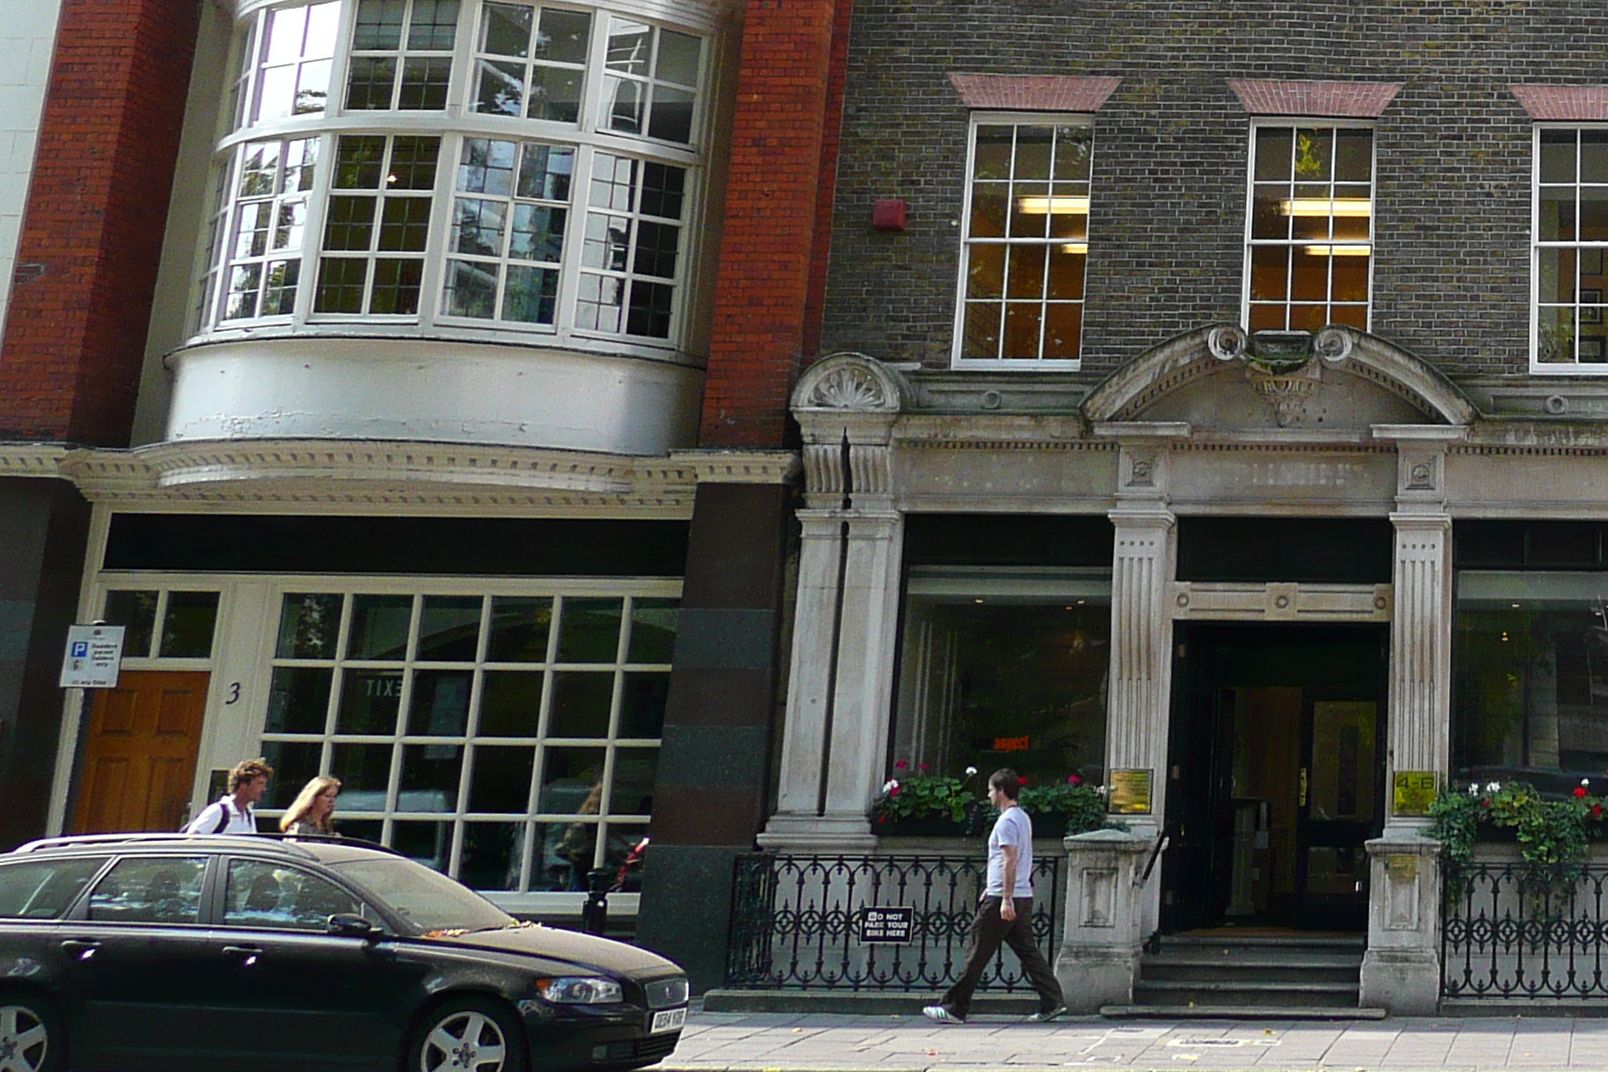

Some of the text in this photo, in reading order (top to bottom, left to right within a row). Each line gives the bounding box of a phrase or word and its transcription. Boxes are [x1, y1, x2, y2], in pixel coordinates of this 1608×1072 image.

[73, 643, 86, 656] P
[226, 682, 241, 705] 3
[1396, 777, 1435, 790] 4-6
[886, 913, 904, 921] NOT
[887, 921, 909, 929] YOUR
